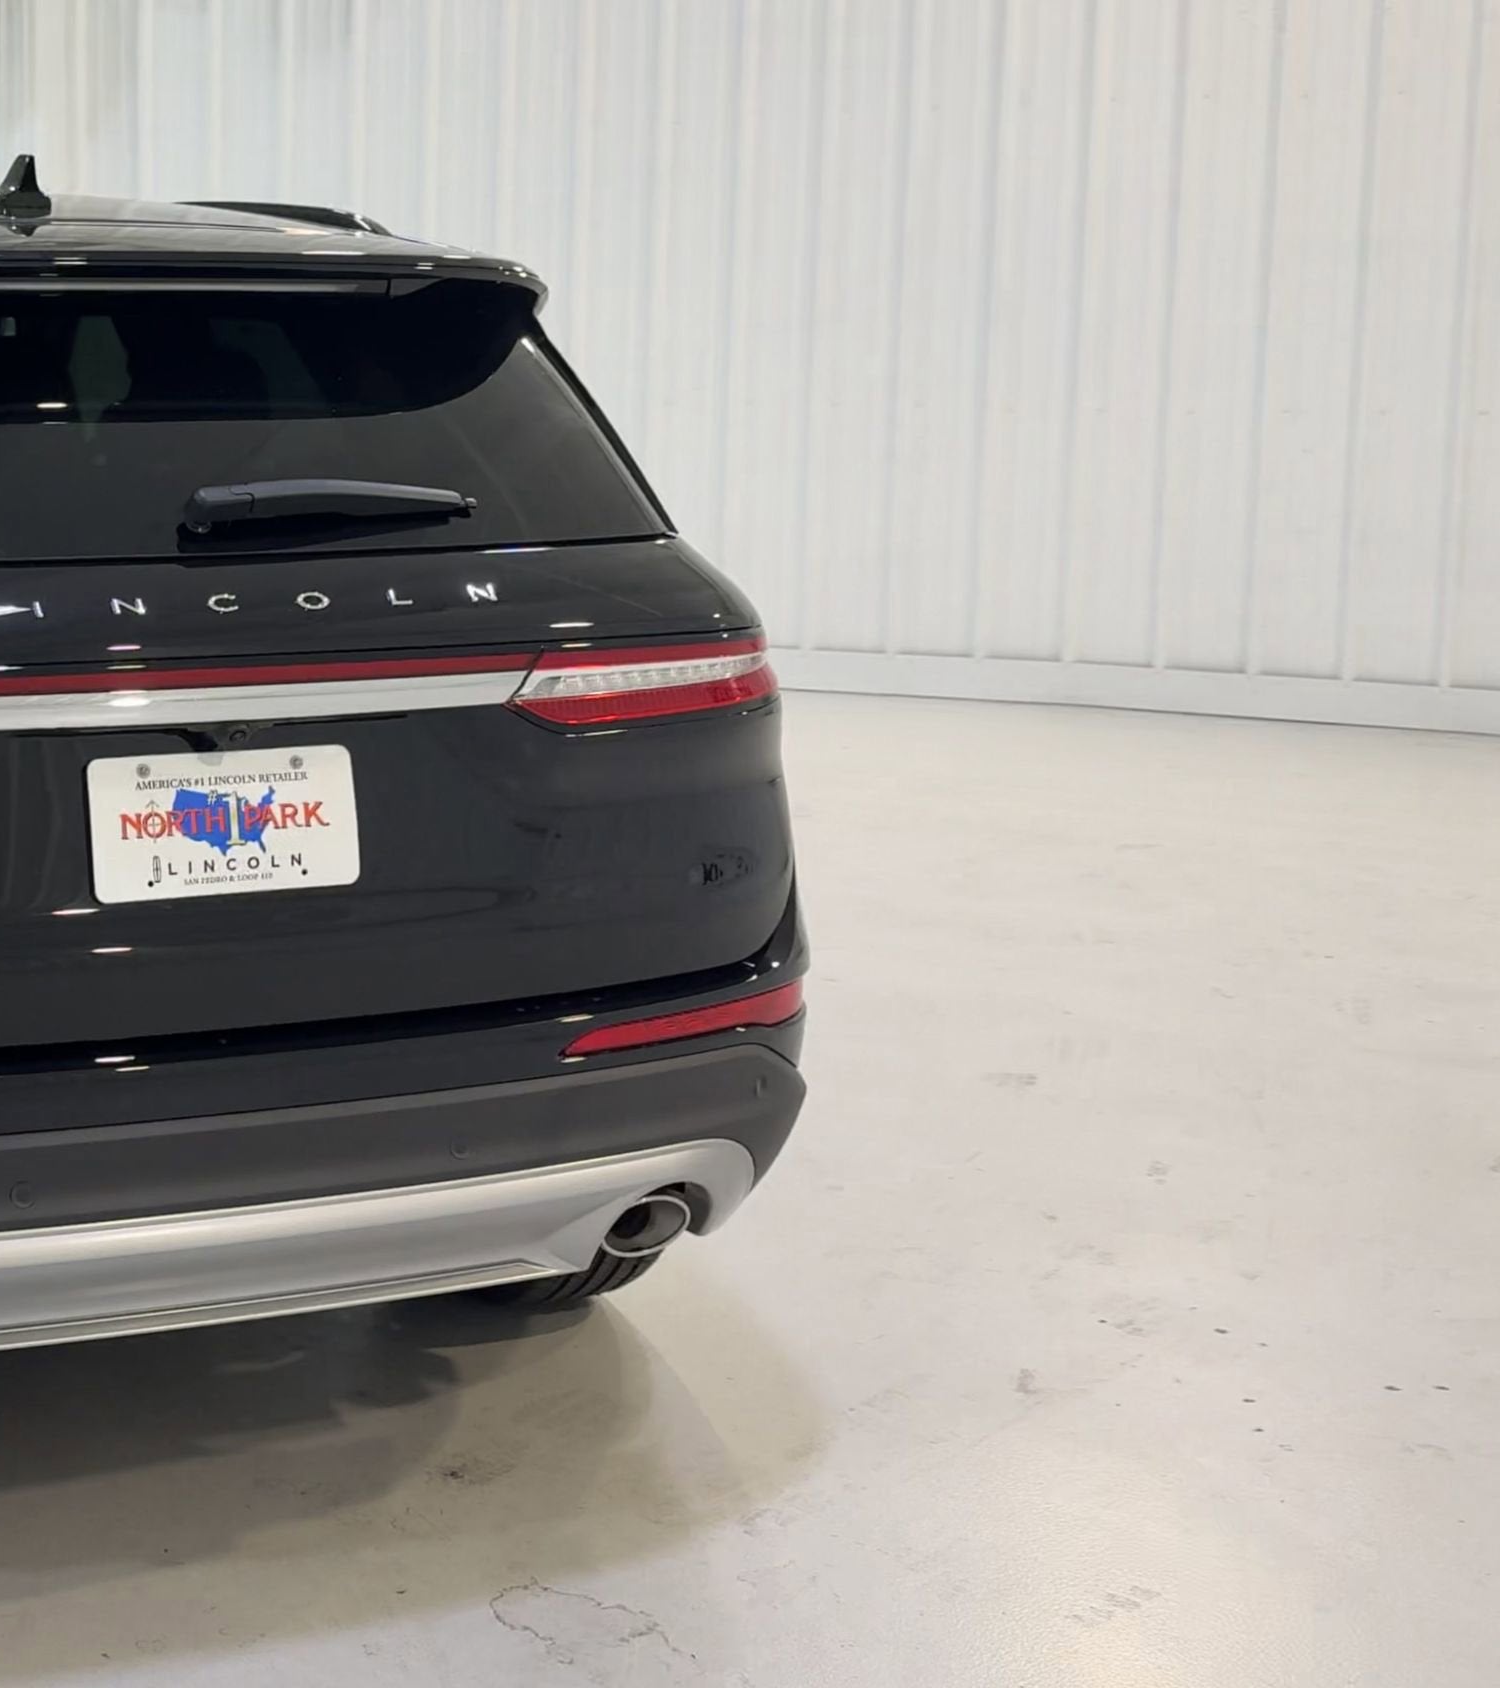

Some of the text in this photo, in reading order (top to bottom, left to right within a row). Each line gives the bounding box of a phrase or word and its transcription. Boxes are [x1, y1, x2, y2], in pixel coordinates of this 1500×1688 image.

[134, 776, 192, 791] AMERICA'S
[208, 773, 256, 787] LINCOLN
[258, 771, 309, 783] RETAILER
[120, 800, 331, 841] NORTH PARK
[167, 853, 303, 876] LINCOLN
